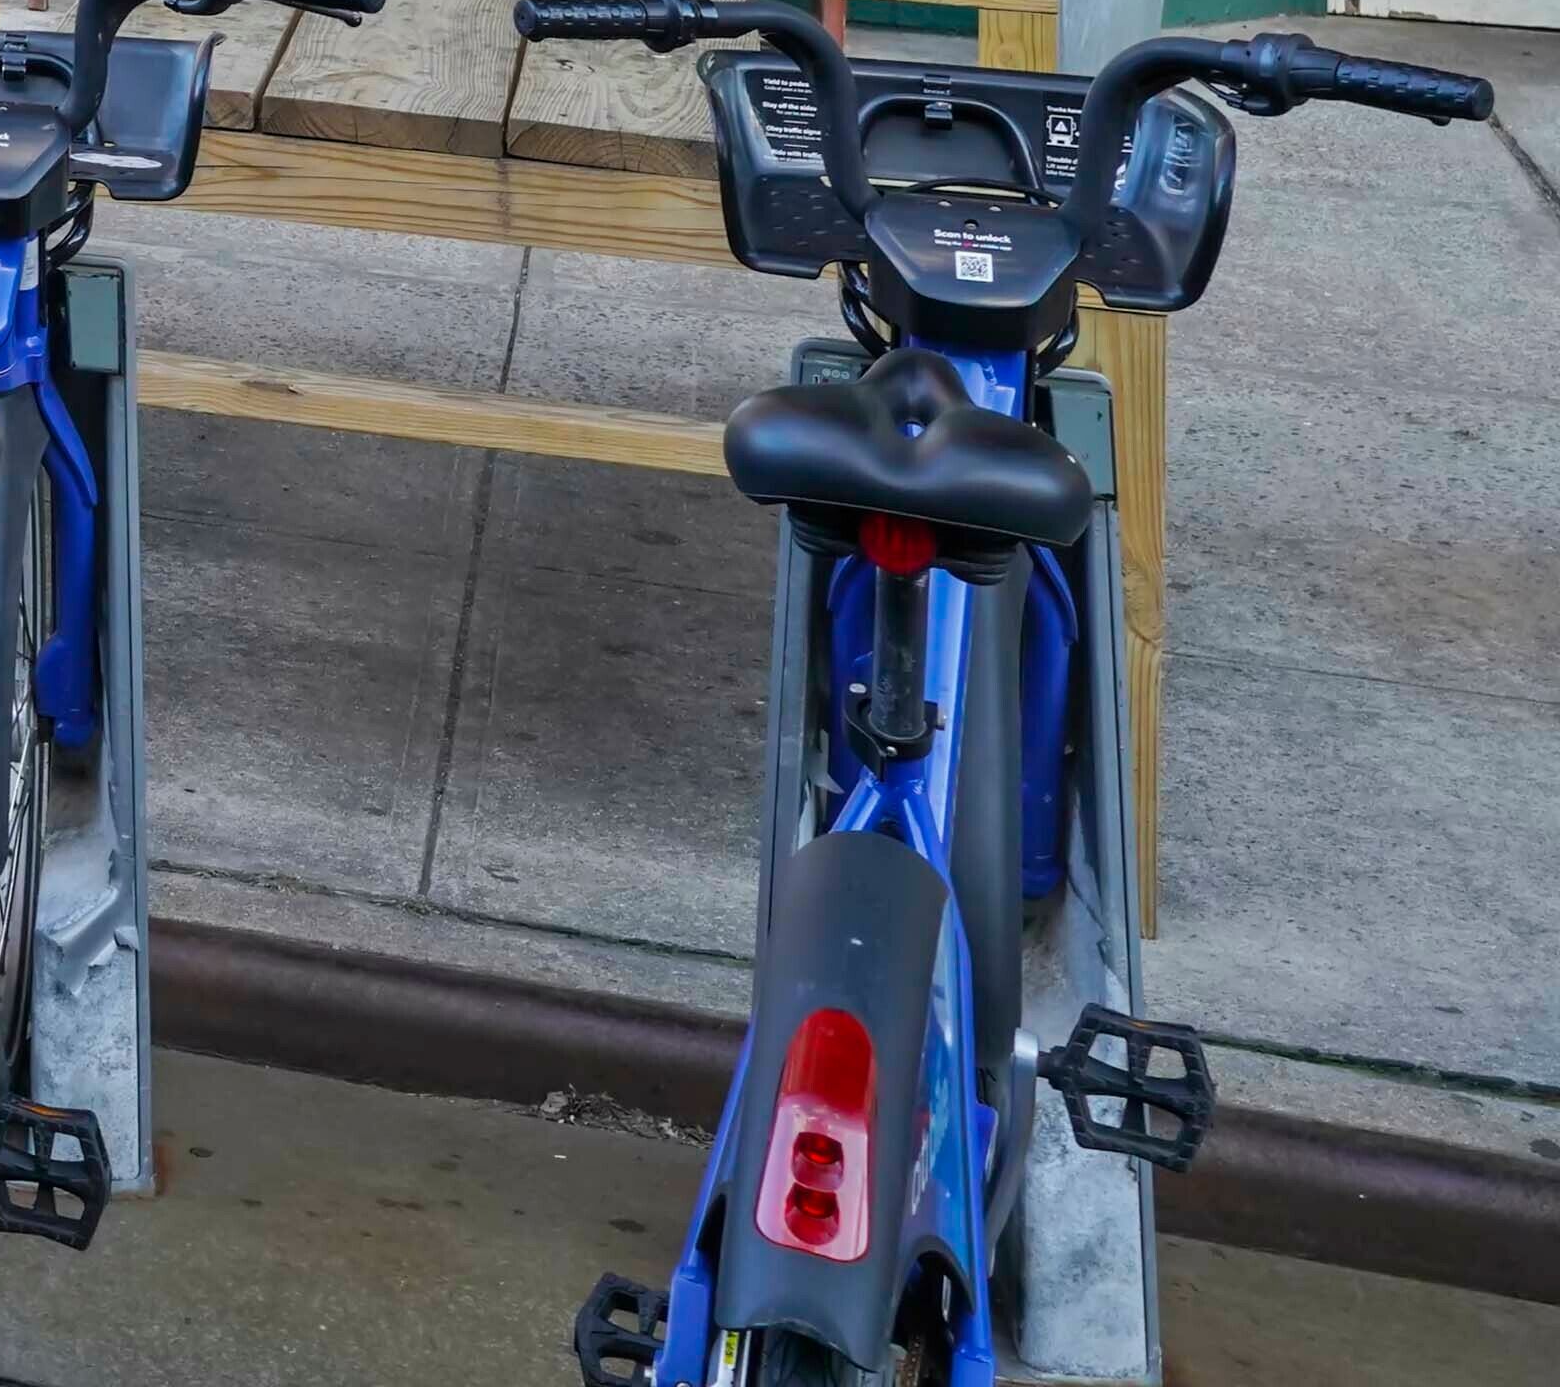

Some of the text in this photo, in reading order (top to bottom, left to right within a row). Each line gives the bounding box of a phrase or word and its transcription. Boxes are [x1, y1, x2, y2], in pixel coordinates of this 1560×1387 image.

[933, 228, 1012, 245] Scan to unlock
